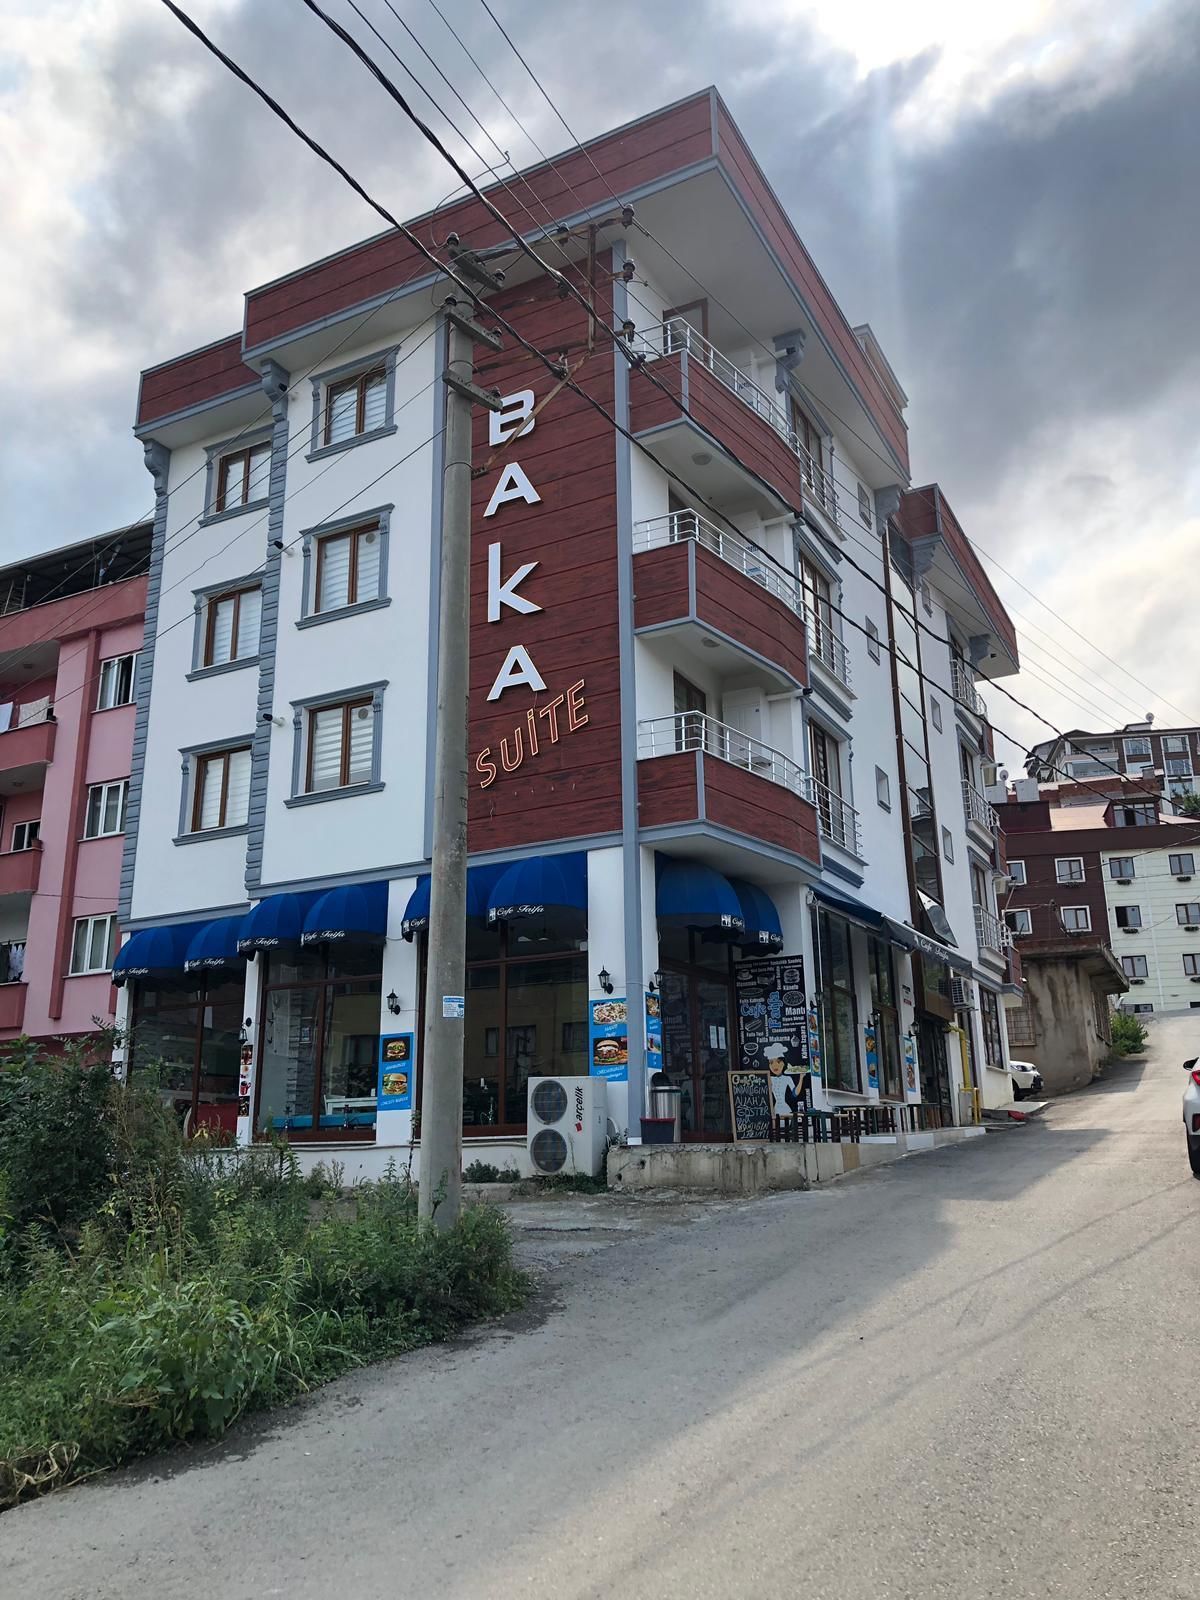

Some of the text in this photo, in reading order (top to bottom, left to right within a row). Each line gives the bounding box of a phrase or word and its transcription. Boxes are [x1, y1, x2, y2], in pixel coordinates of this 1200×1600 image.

[496, 906, 514, 916] Cafe
[410, 917, 426, 928] Cafe
[732, 917, 743, 927] Cafe
[304, 932, 318, 941] Cafe
[770, 934, 782, 943] Cafe
[740, 1003, 767, 1018] Cafe
[575, 1086, 584, 1122] arçelik
